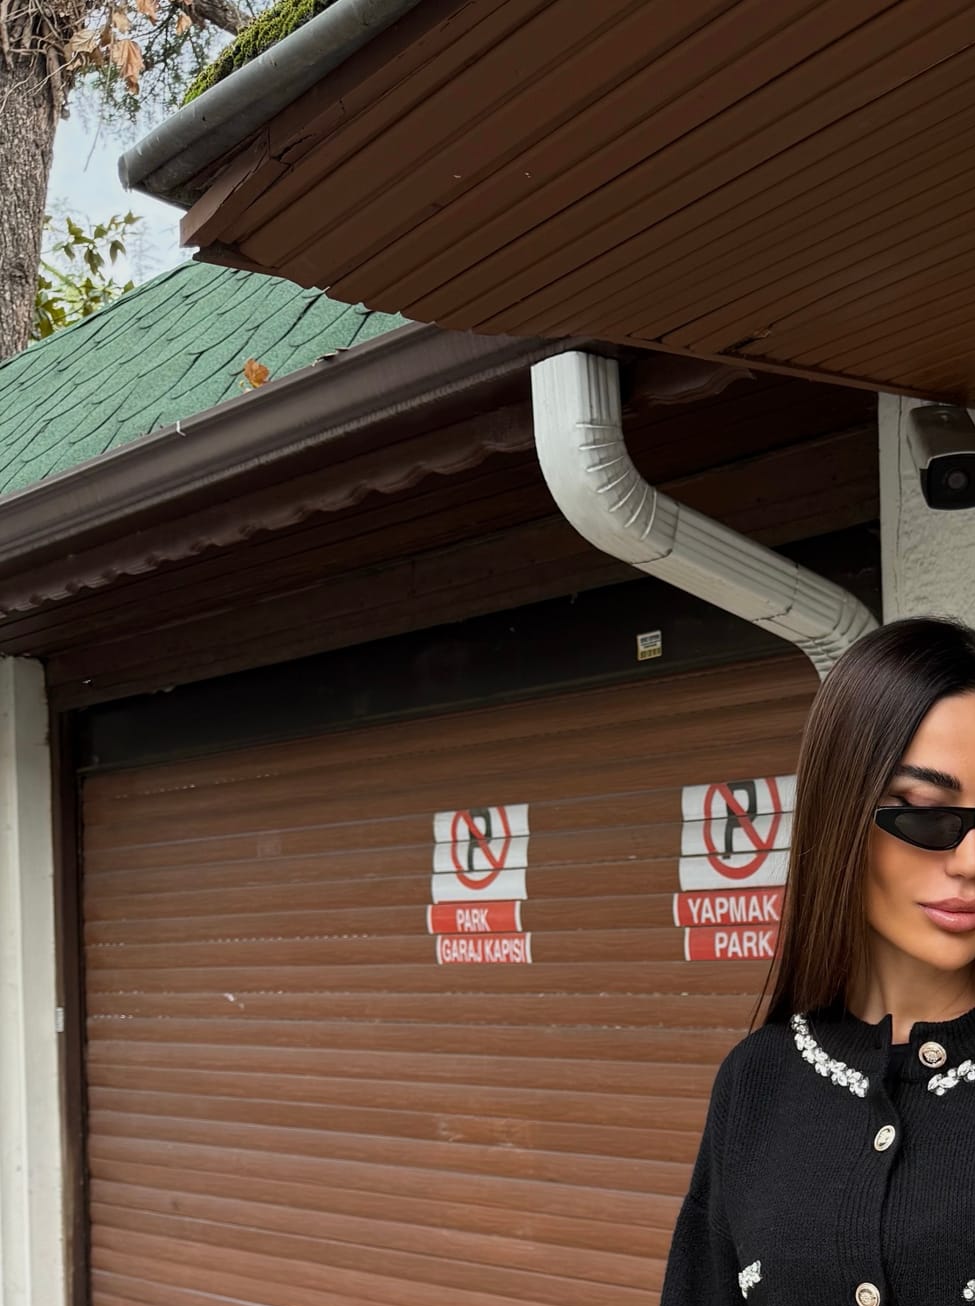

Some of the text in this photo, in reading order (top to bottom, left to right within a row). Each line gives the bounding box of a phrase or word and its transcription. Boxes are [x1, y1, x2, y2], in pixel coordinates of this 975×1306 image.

[456, 908, 492, 932] PARK
[688, 893, 780, 923] YAPMAK
[441, 937, 526, 963] GARAJ KAPISI
[715, 930, 776, 958] PARK
